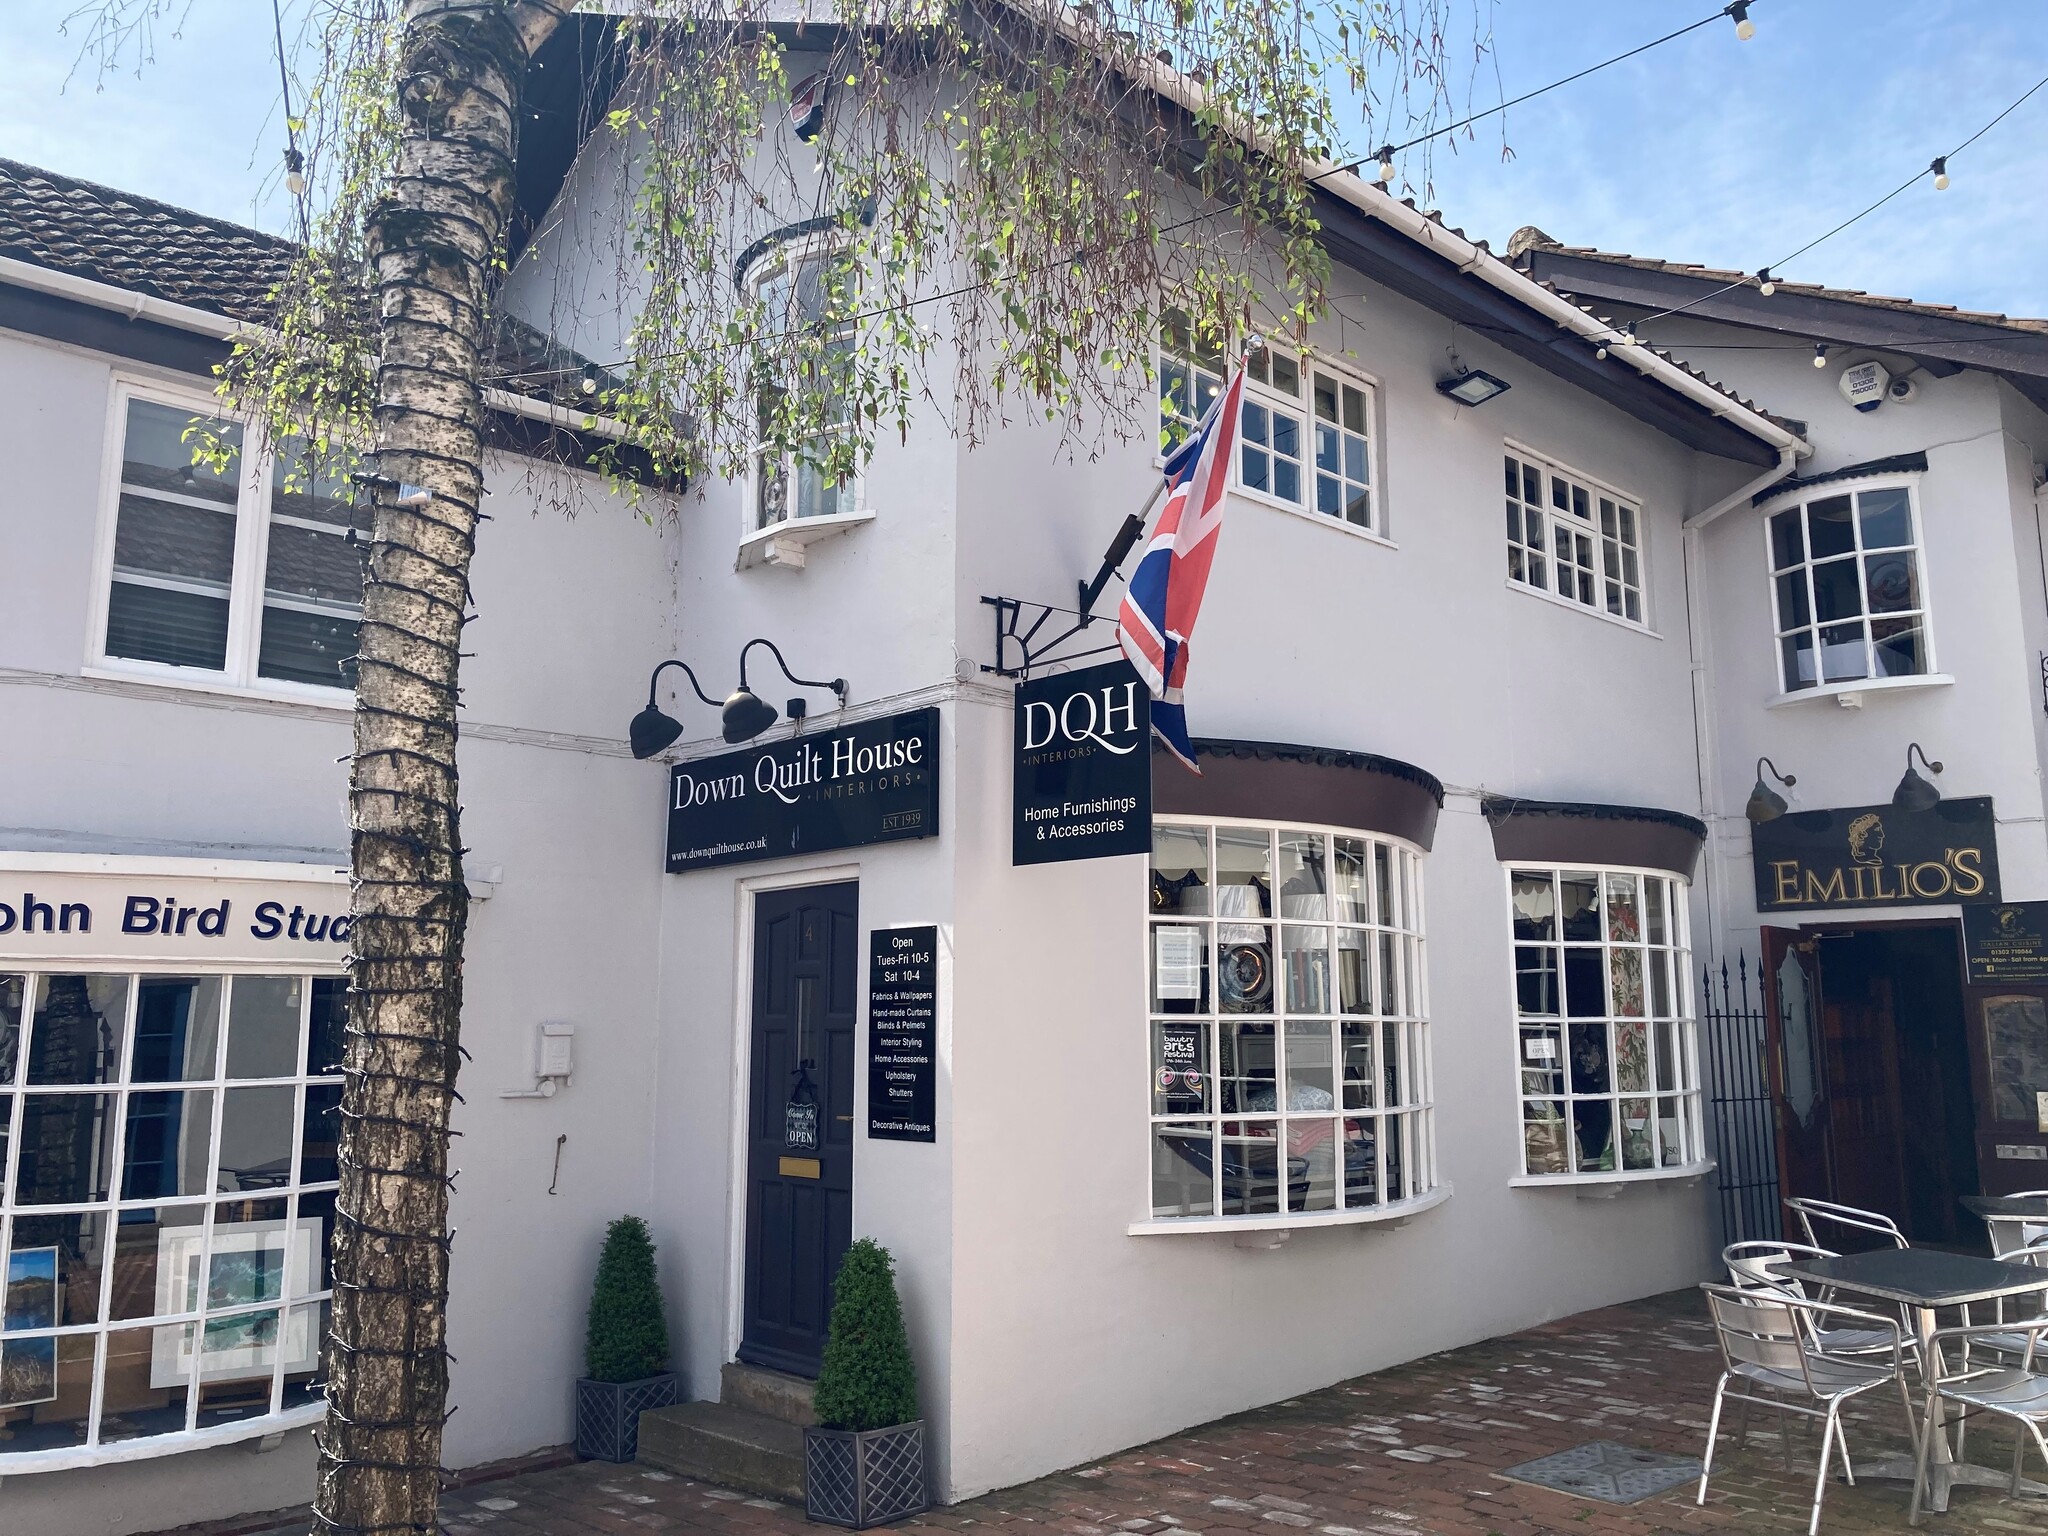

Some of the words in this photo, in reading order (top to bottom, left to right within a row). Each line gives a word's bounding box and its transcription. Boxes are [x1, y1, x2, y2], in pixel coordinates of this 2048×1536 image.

[1023, 681, 1138, 754] DQH
[674, 773, 745, 810] Down
[755, 744, 823, 804] Quilt
[831, 736, 923, 779] House
[816, 772, 911, 802] INTERIORS
[1025, 805, 1059, 822] Home
[1063, 796, 1136, 817] Furnishings
[883, 816, 899, 829] EST
[901, 812, 921, 826] 1939
[1036, 826, 1046, 840] &
[1049, 818, 1125, 839] Accessories
[671, 836, 767, 861] www.downquilthouse.co.uk
[1768, 847, 1985, 904] EMILIO'S
[121, 895, 231, 936] Bird
[892, 937, 913, 950] Open
[877, 953, 909, 966] Tues-Fri
[911, 952, 929, 964] 10-5
[884, 971, 898, 982] Sat
[902, 970, 920, 981] 10-4
[872, 992, 893, 1001] Fabrics
[900, 992, 933, 1001] Wallpapers
[873, 1009, 905, 1017] Hand-made
[906, 1008, 931, 1017] Curtains
[877, 1021, 895, 1030] Blinds
[902, 1021, 926, 1030] Pelmets
[880, 1038, 901, 1046] Interior
[902, 1037, 922, 1048] Styling
[1164, 1035, 1195, 1043] bawtry
[1164, 1042, 1195, 1052] arts
[874, 1054, 891, 1063] Home
[893, 1054, 928, 1064] Accessories
[885, 1071, 916, 1082] Upholstery
[888, 1088, 913, 1097] Shutters
[872, 1120, 903, 1130] Decorative
[904, 1122, 930, 1133] Antiques
[790, 1130, 813, 1144] OPEN
